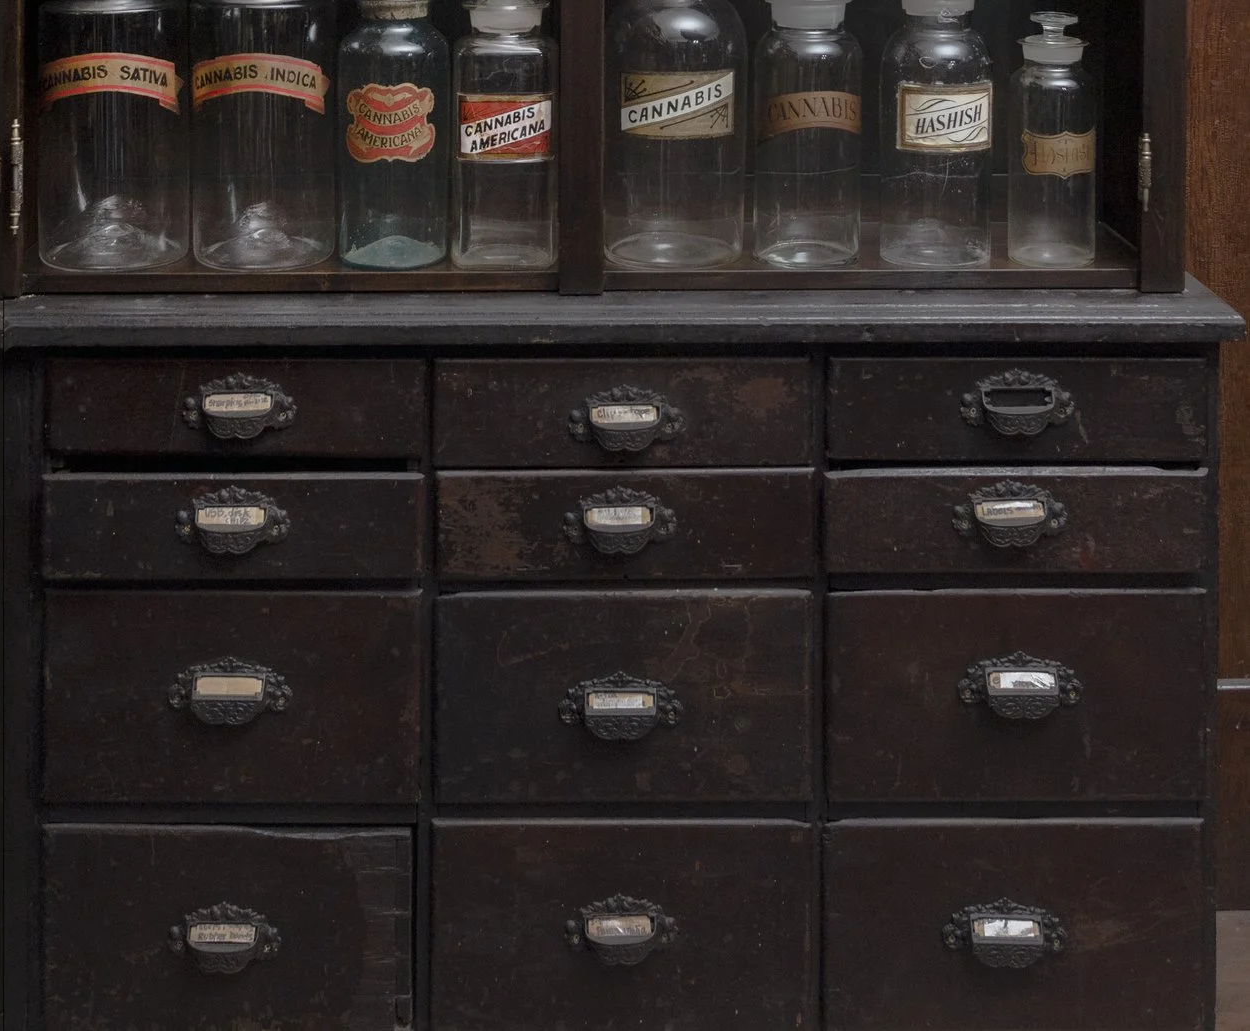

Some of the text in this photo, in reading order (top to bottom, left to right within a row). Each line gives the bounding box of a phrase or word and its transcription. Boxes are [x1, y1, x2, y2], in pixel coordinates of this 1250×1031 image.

[43, 64, 168, 91] CANNABIS SATIVA
[195, 64, 316, 90] CANNABIS INDICA
[358, 102, 421, 126] CANNABIS
[627, 83, 723, 124] CANNABIS
[768, 97, 858, 123] CANNABIS
[464, 106, 535, 137] CANNABIS
[915, 103, 983, 136] HASHISH
[356, 124, 423, 149] AMERICANA
[469, 119, 546, 153] AMERICANA
